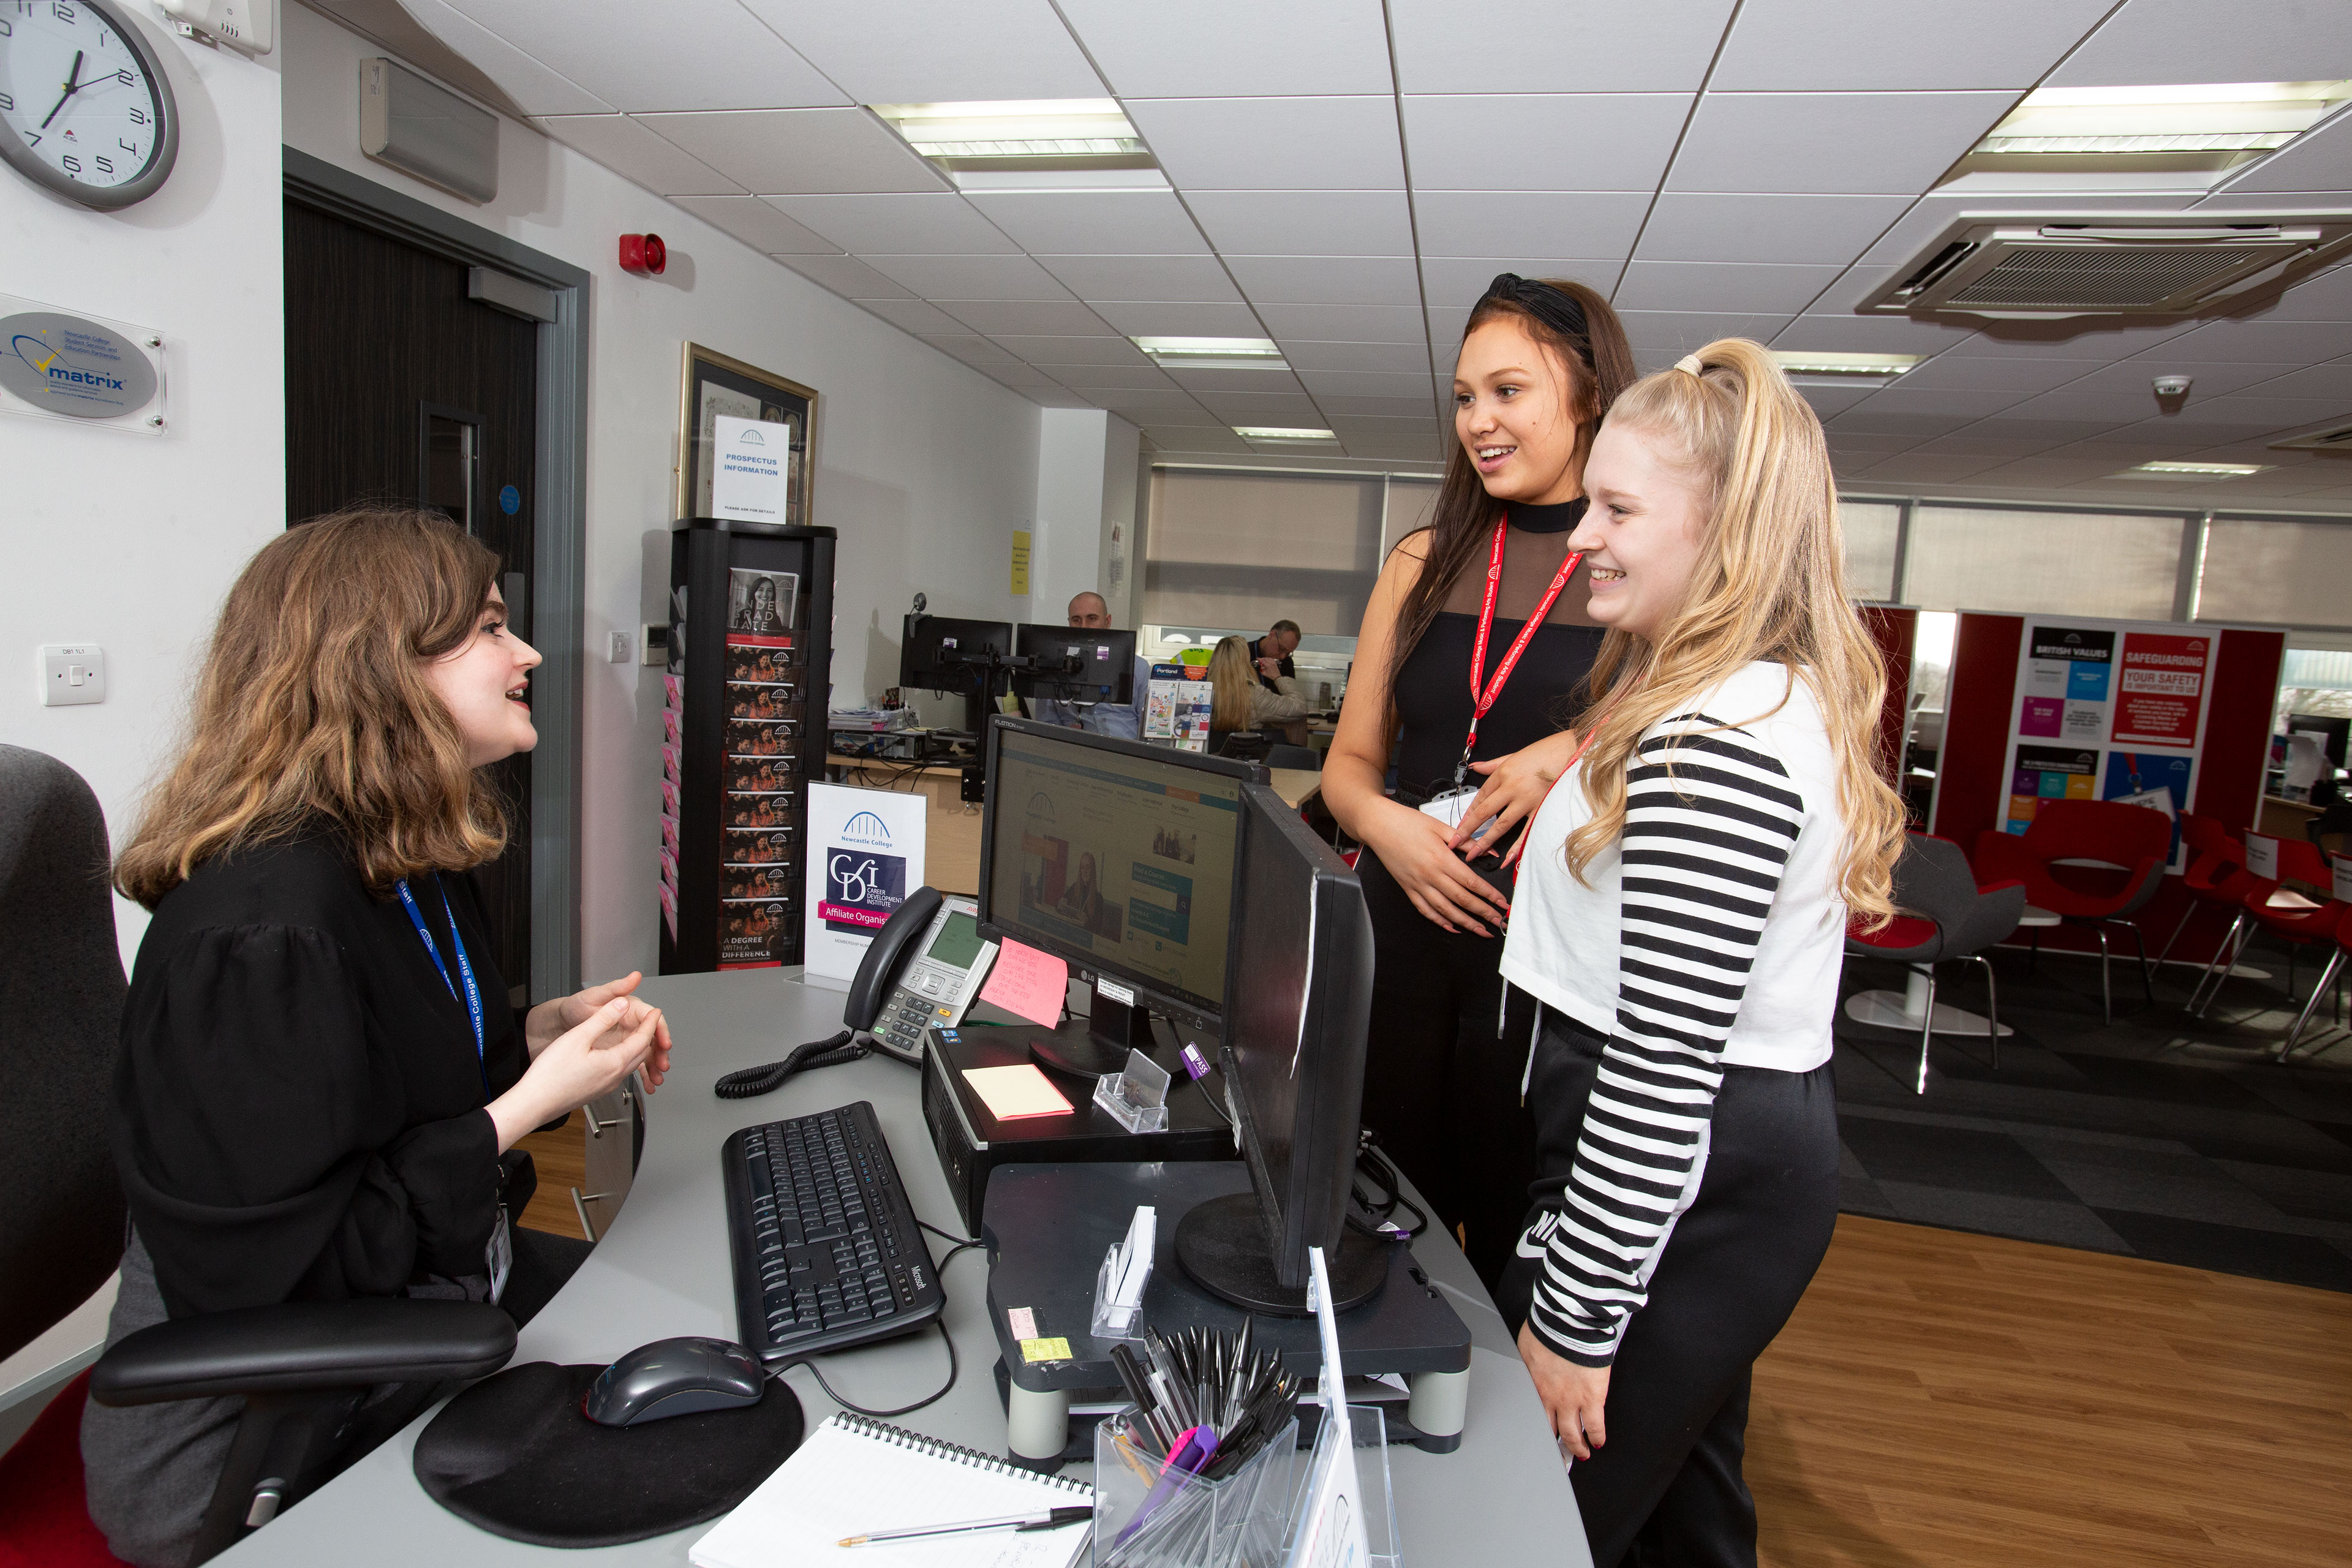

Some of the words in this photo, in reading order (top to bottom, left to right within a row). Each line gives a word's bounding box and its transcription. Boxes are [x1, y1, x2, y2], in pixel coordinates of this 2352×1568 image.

[53, 2, 75, 24] 12
[118, 69, 134, 87] 2
[130, 107, 145, 124] 3
[24, 130, 42, 147] 7
[119, 138, 136, 156] 4
[63, 155, 81, 172] 6
[96, 156, 113, 173] 5
[64, 330, 91, 340] Newcastle
[92, 336, 110, 345] College
[86, 342, 106, 350] Services
[65, 344, 89, 353] Education
[92, 350, 121, 360] Partnerships
[49, 368, 124, 390] matrix
[726, 454, 777, 466] PROSPECTUS
[725, 464, 778, 476] INFORMATION
[1562, 556, 1575, 574] Student
[1539, 590, 1555, 611] Newcastle
[1481, 605, 1490, 628] Performing
[1529, 612, 1542, 628] College
[1522, 627, 1532, 640] Music
[1504, 643, 1523, 666] Performing
[2036, 645, 2071, 656] BRITISH
[2073, 647, 2108, 658] VALUES
[2125, 652, 2204, 668] SAFEGUARDING
[1491, 674, 1504, 694] Student
[2126, 672, 2155, 683] YOUR
[2158, 674, 2198, 685] SAFETY
[995, 719, 1016, 728] FLATRON
[841, 835, 870, 844] Newcastle
[871, 840, 893, 848] College
[399, 880, 412, 904] Staff
[867, 894, 903, 903] DEVELOPMENT
[867, 899, 891, 908] INSTITUTE
[826, 908, 854, 920] Affiliate
[856, 912, 888, 925] Organis
[1088, 974, 1095, 982] LG
[467, 978, 479, 1014] College
[1194, 1057, 1208, 1073] PASS
[911, 1265, 927, 1290] Microsoft
